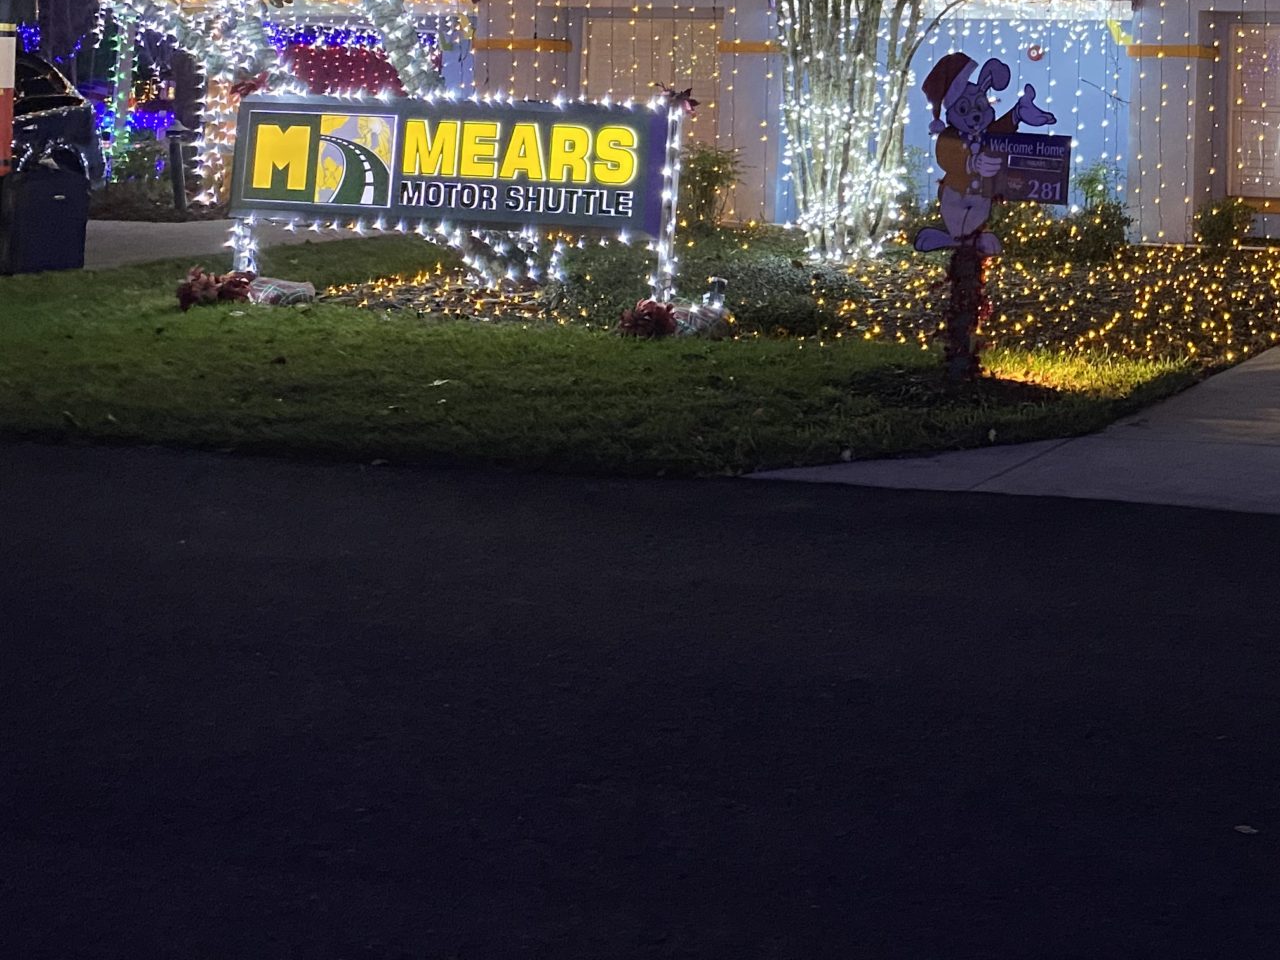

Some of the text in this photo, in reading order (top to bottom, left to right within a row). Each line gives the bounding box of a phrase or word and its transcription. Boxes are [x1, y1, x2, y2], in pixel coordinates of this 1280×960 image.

[253, 125, 310, 189] M
[402, 118, 638, 186] MEARS
[990, 138, 1065, 157] Welcome Home
[400, 181, 634, 218] MOTOR SHUTTLE
[1027, 179, 1062, 200] 281
